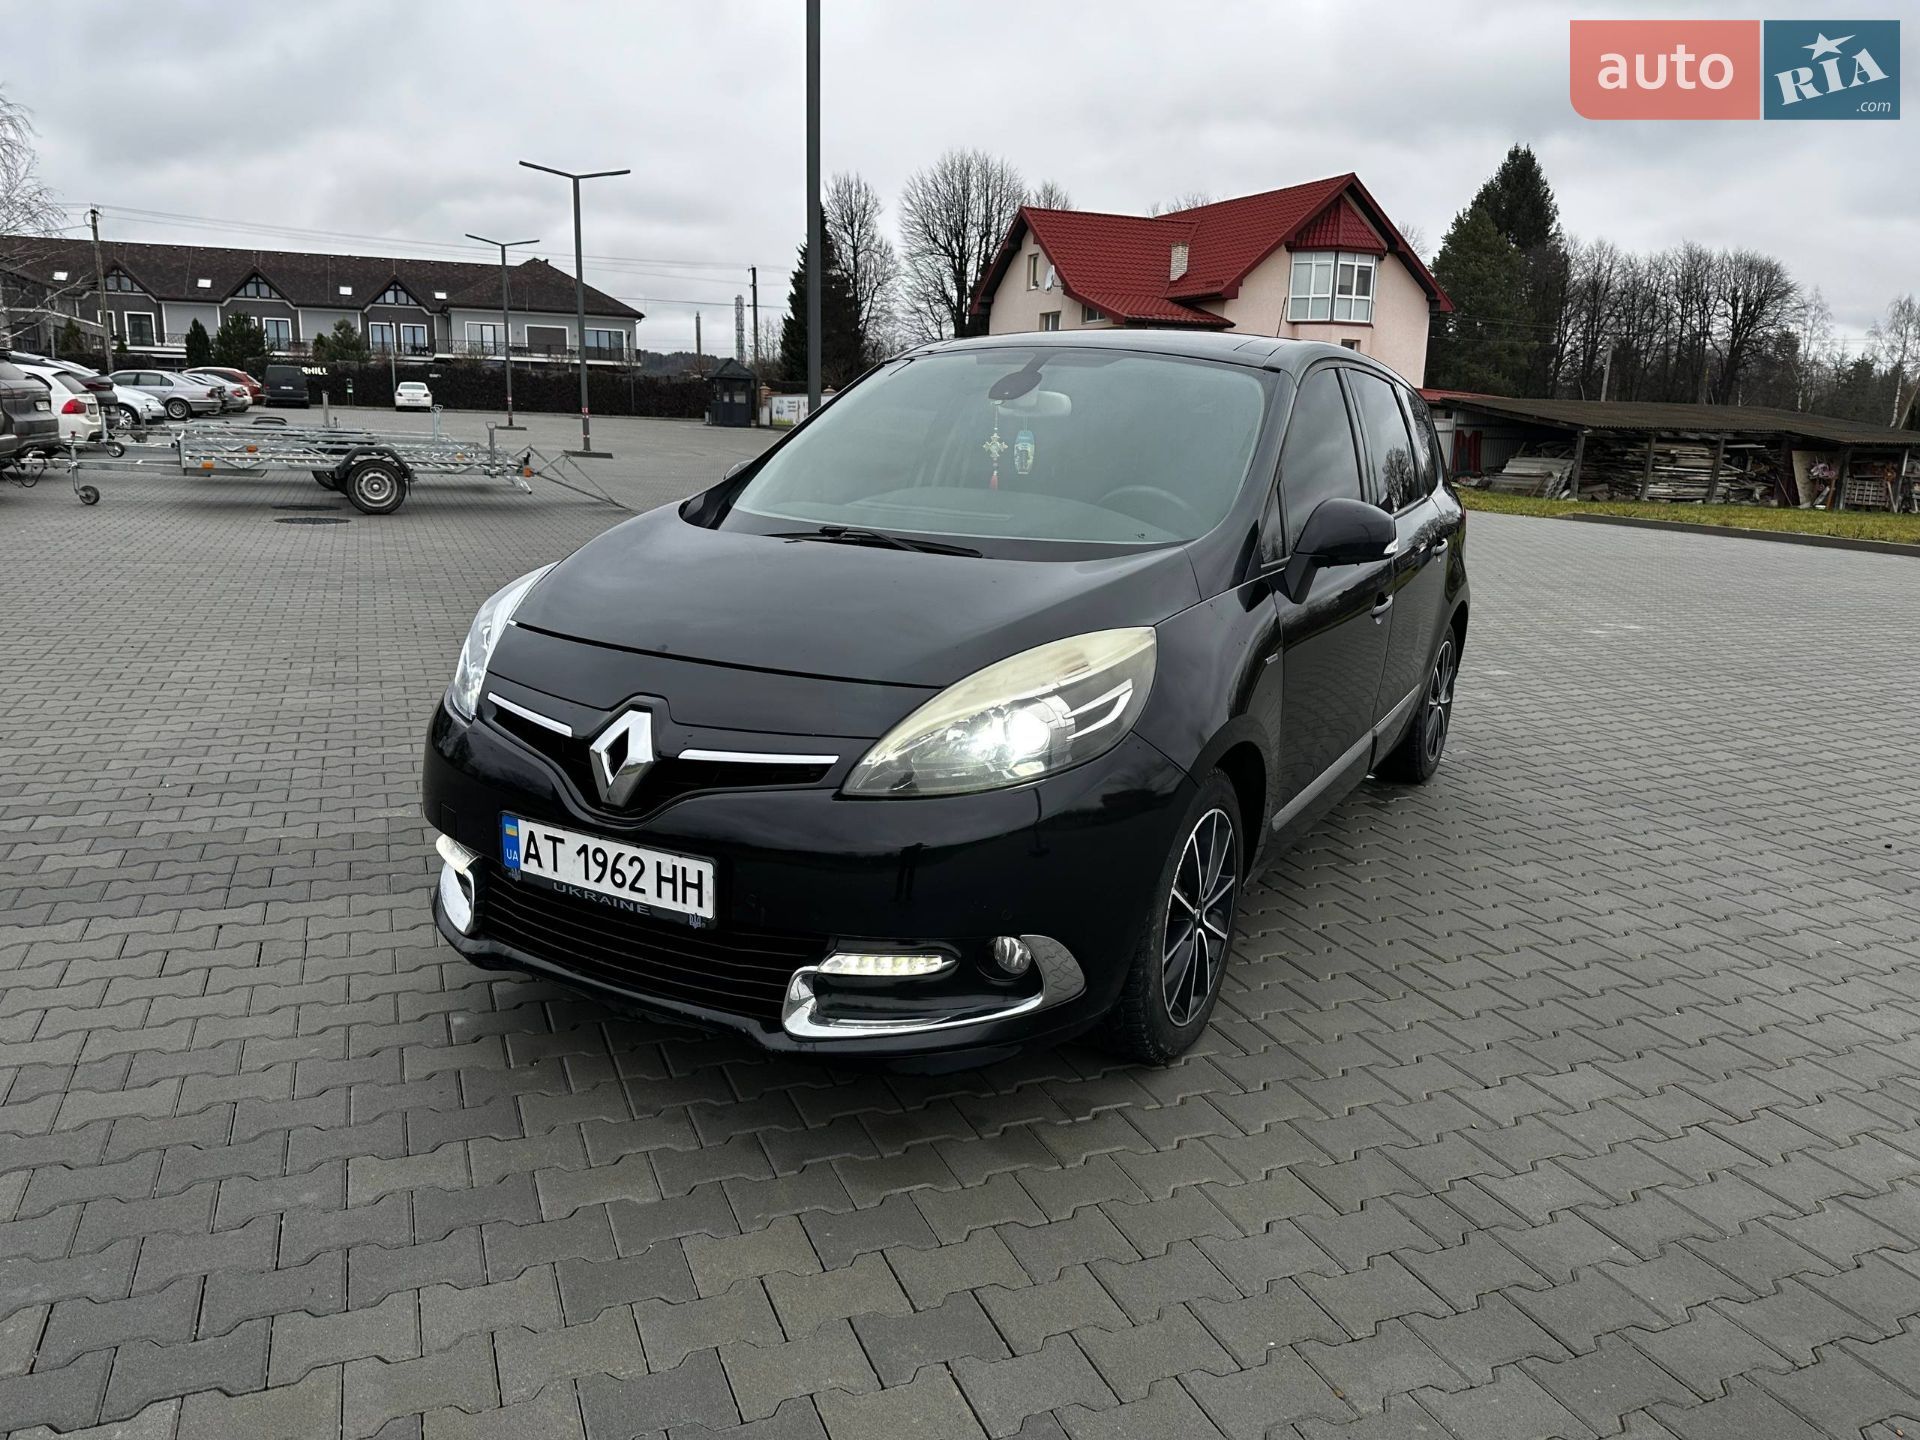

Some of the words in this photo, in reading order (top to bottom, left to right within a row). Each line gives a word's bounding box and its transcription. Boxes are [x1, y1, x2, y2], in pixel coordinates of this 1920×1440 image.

[506, 848, 519, 862] UA
[523, 830, 565, 872] AT
[576, 843, 646, 894] 1962
[656, 861, 703, 908] HH
[553, 882, 650, 916] UKRAINE
